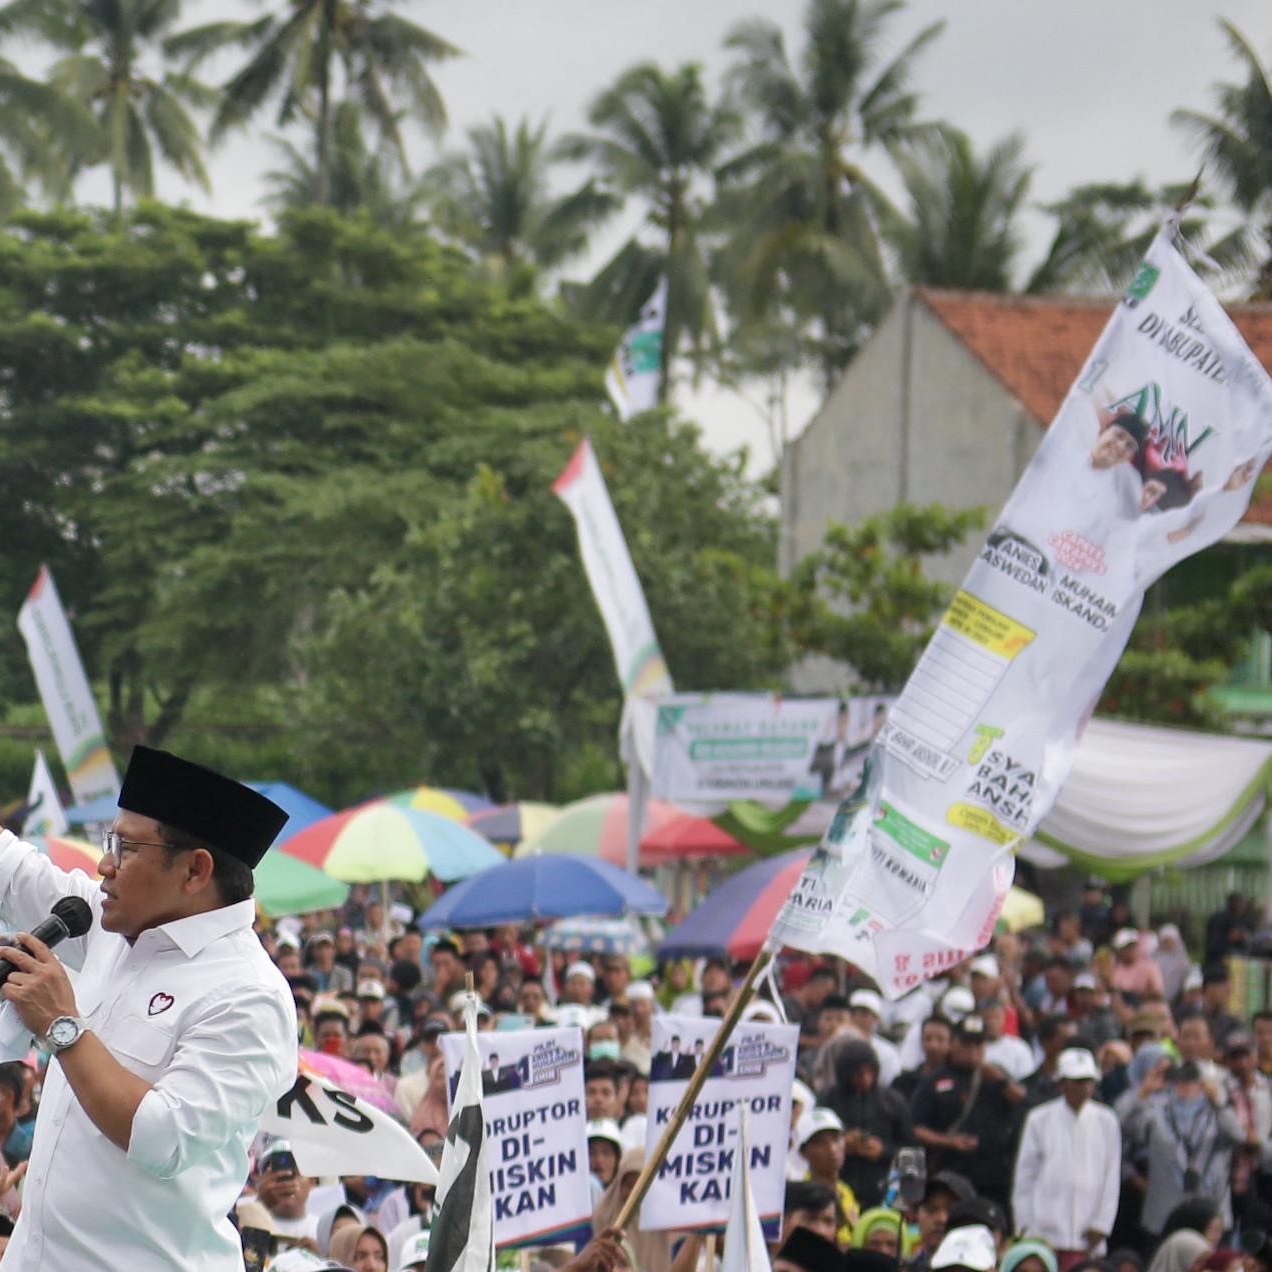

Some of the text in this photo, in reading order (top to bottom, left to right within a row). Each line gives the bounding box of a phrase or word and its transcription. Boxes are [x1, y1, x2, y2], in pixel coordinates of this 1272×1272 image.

[981, 550, 1049, 595] ASWEDAN
[1051, 588, 1109, 633] ISKAND
[276, 1074, 375, 1134] KS
[485, 1099, 581, 1139] RUPTOR
[656, 1095, 782, 1126] KRUPOR
[501, 1133, 546, 1163] DI-
[693, 1122, 738, 1149] DI-
[658, 1144, 772, 1180] MISKN
[495, 1182, 557, 1221] KAN
